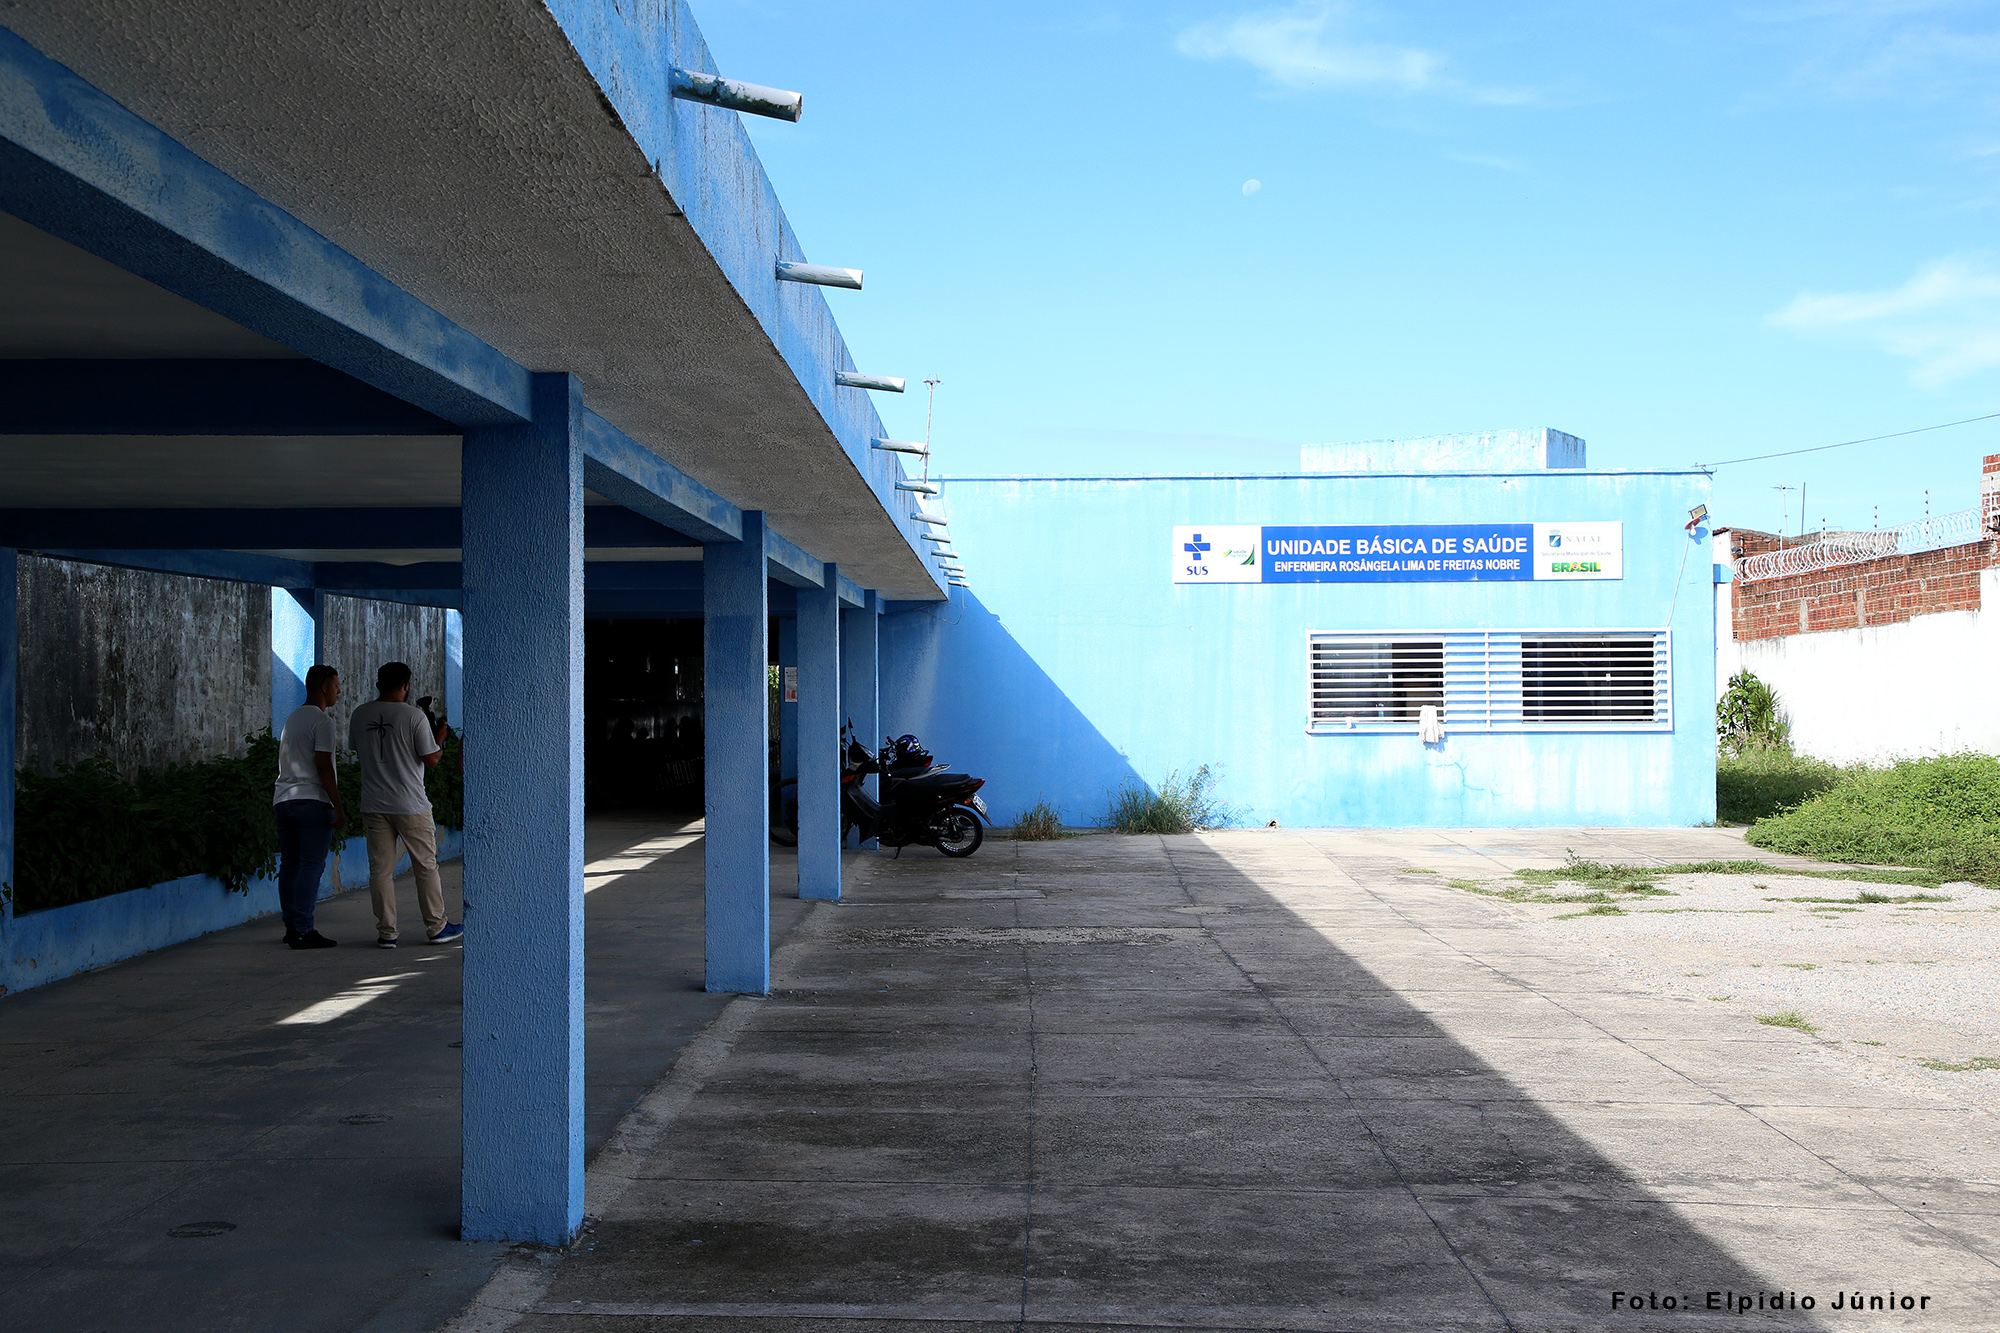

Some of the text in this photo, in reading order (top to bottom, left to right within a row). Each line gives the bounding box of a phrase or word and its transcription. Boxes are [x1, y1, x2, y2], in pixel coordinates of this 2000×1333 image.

[1267, 534, 1528, 555] UNIDADE BÁSICA DE SAÚDE
[1186, 566, 1208, 575] SUS
[1274, 558, 1520, 572] ENFERMEIRA ROSÂNGELA LIMA DE FREITAS NOBRE
[1552, 562, 1601, 572] BRASIL
